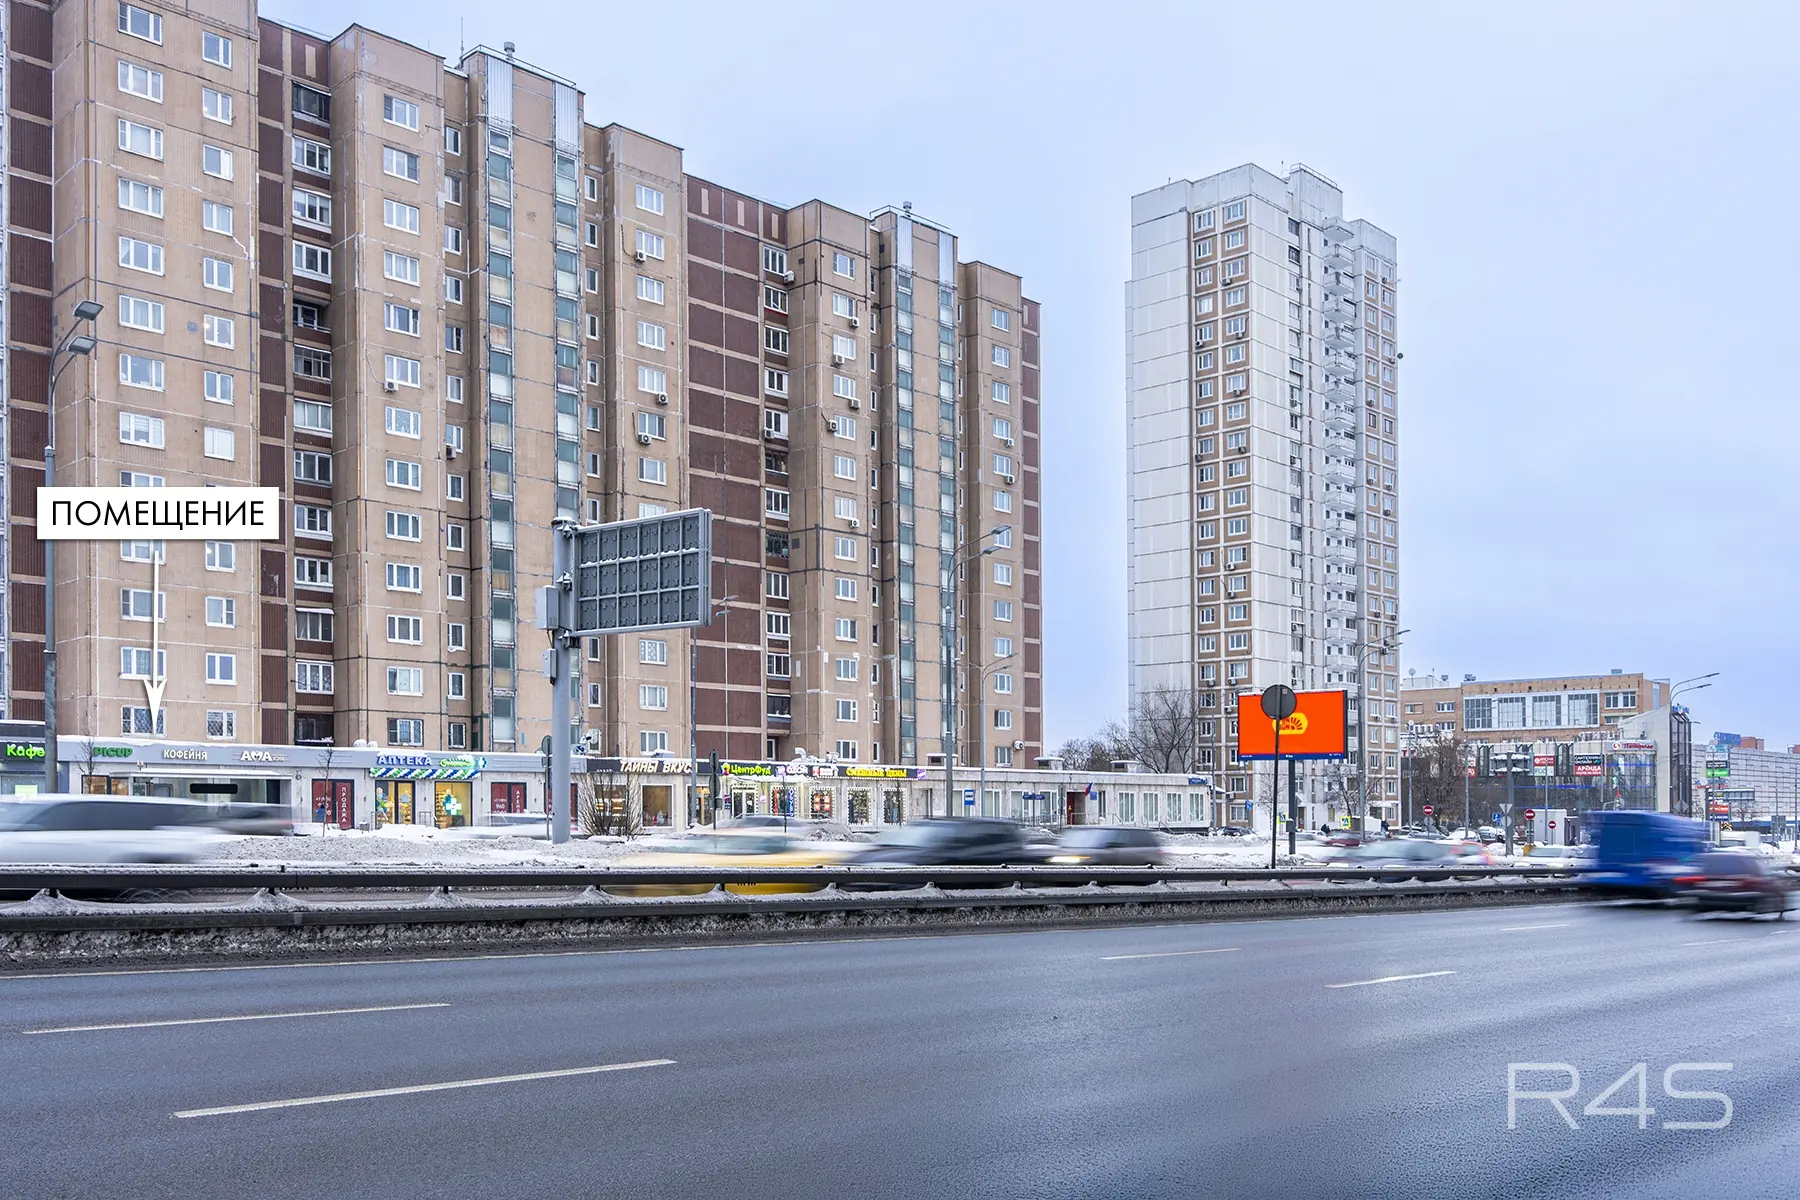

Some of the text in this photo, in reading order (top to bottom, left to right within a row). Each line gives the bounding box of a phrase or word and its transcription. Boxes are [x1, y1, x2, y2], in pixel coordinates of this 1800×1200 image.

[6, 743, 46, 759] Кафе
[92, 746, 133, 758] PICUP
[163, 748, 208, 761] КОФЕЙНЯ
[376, 755, 432, 767] АПТЕКА
[662, 760, 698, 773] ВКУС
